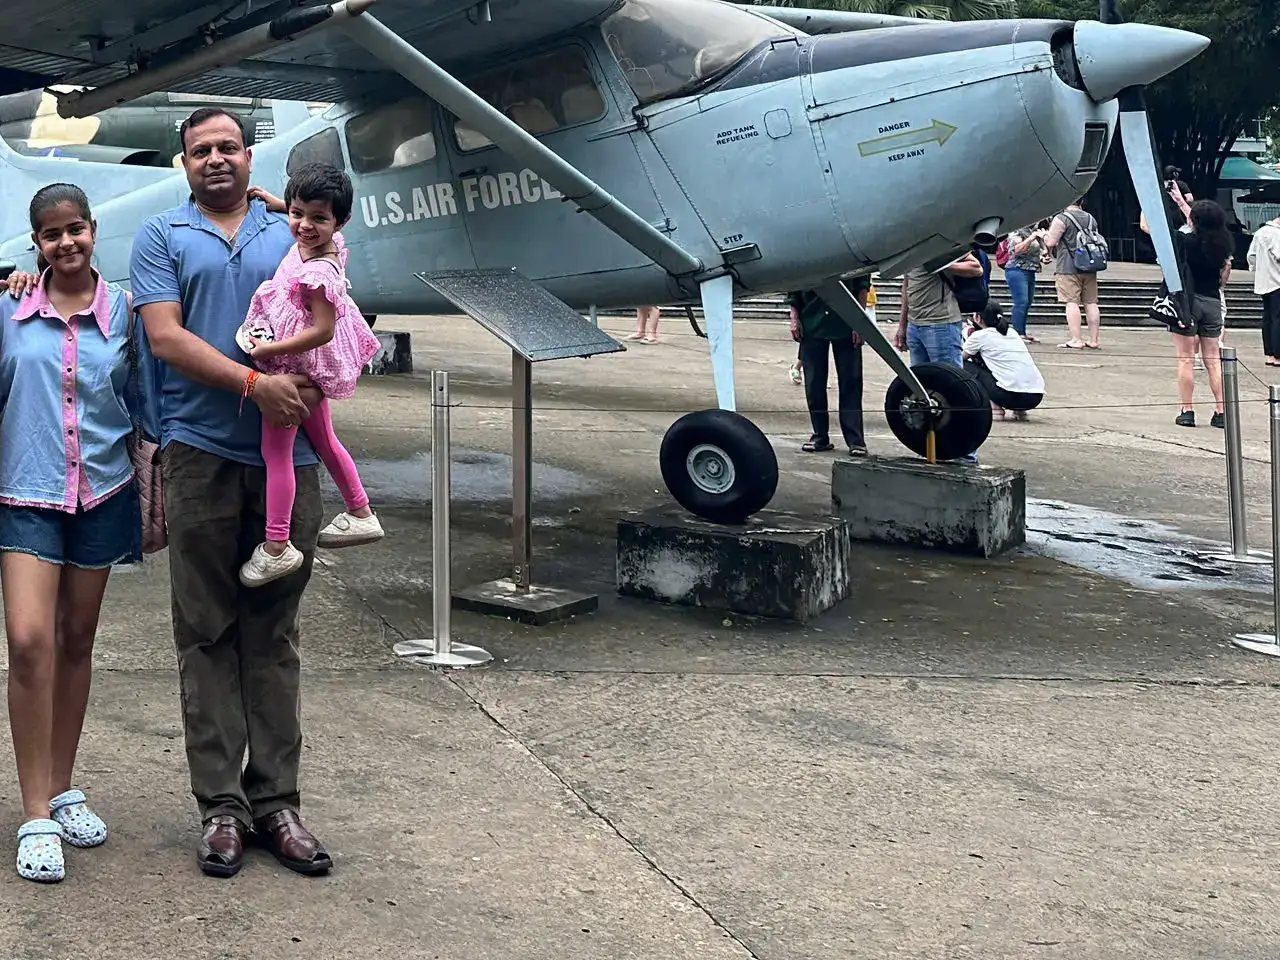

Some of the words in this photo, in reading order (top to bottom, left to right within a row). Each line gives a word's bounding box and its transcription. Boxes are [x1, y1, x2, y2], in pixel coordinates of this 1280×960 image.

[717, 130, 732, 139] ADD
[733, 124, 755, 134] TANK
[878, 121, 911, 134] DANGER
[716, 130, 759, 145] REFUELING
[888, 152, 905, 162] KEEP
[906, 148, 925, 159] AWAY
[723, 233, 743, 244] STEP
